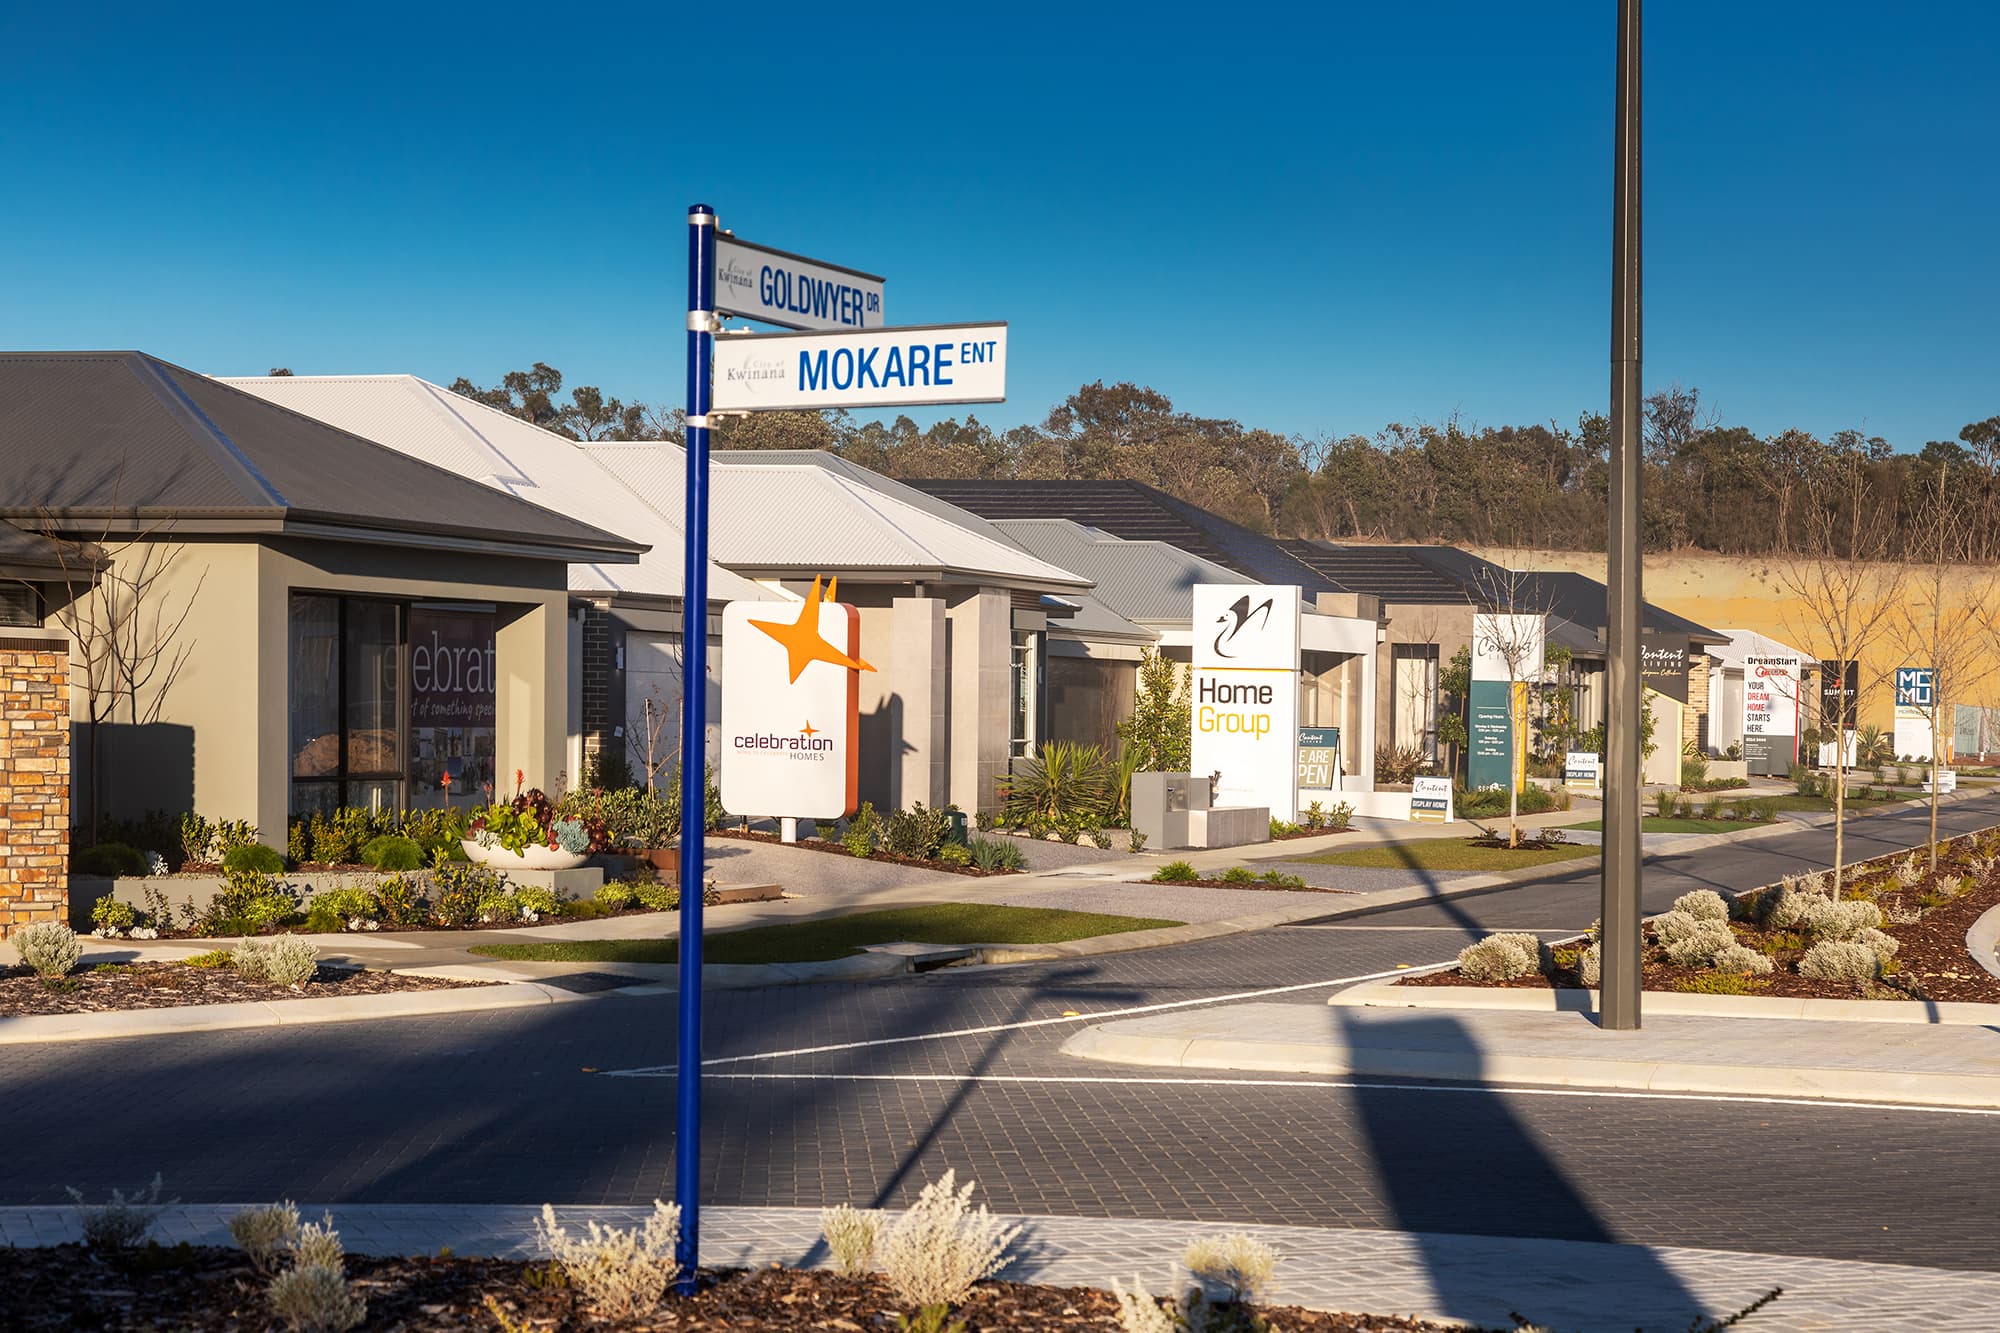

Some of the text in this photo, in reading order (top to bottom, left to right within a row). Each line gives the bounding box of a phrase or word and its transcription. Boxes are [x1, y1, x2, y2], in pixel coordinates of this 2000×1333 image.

[718, 268, 753, 288] Kwinana
[760, 265, 880, 328] GOLDWYER DR
[799, 341, 997, 391] MOKARE ENT
[727, 367, 785, 381] Kwinana
[1747, 657, 1798, 666] DreamStart
[1199, 677, 1273, 704] Home
[1747, 681, 1765, 690] YOUR
[1747, 692, 1770, 701] DREAM
[420, 697, 430, 718] of
[431, 698, 473, 720] something
[1747, 703, 1765, 712] HOME
[1199, 706, 1271, 740] Group
[1746, 713, 1771, 722] STARTS
[734, 732, 833, 751] celebration
[789, 752, 825, 761] HOMES
[1308, 750, 1330, 763] ARE
[1415, 780, 1448, 793] Content
